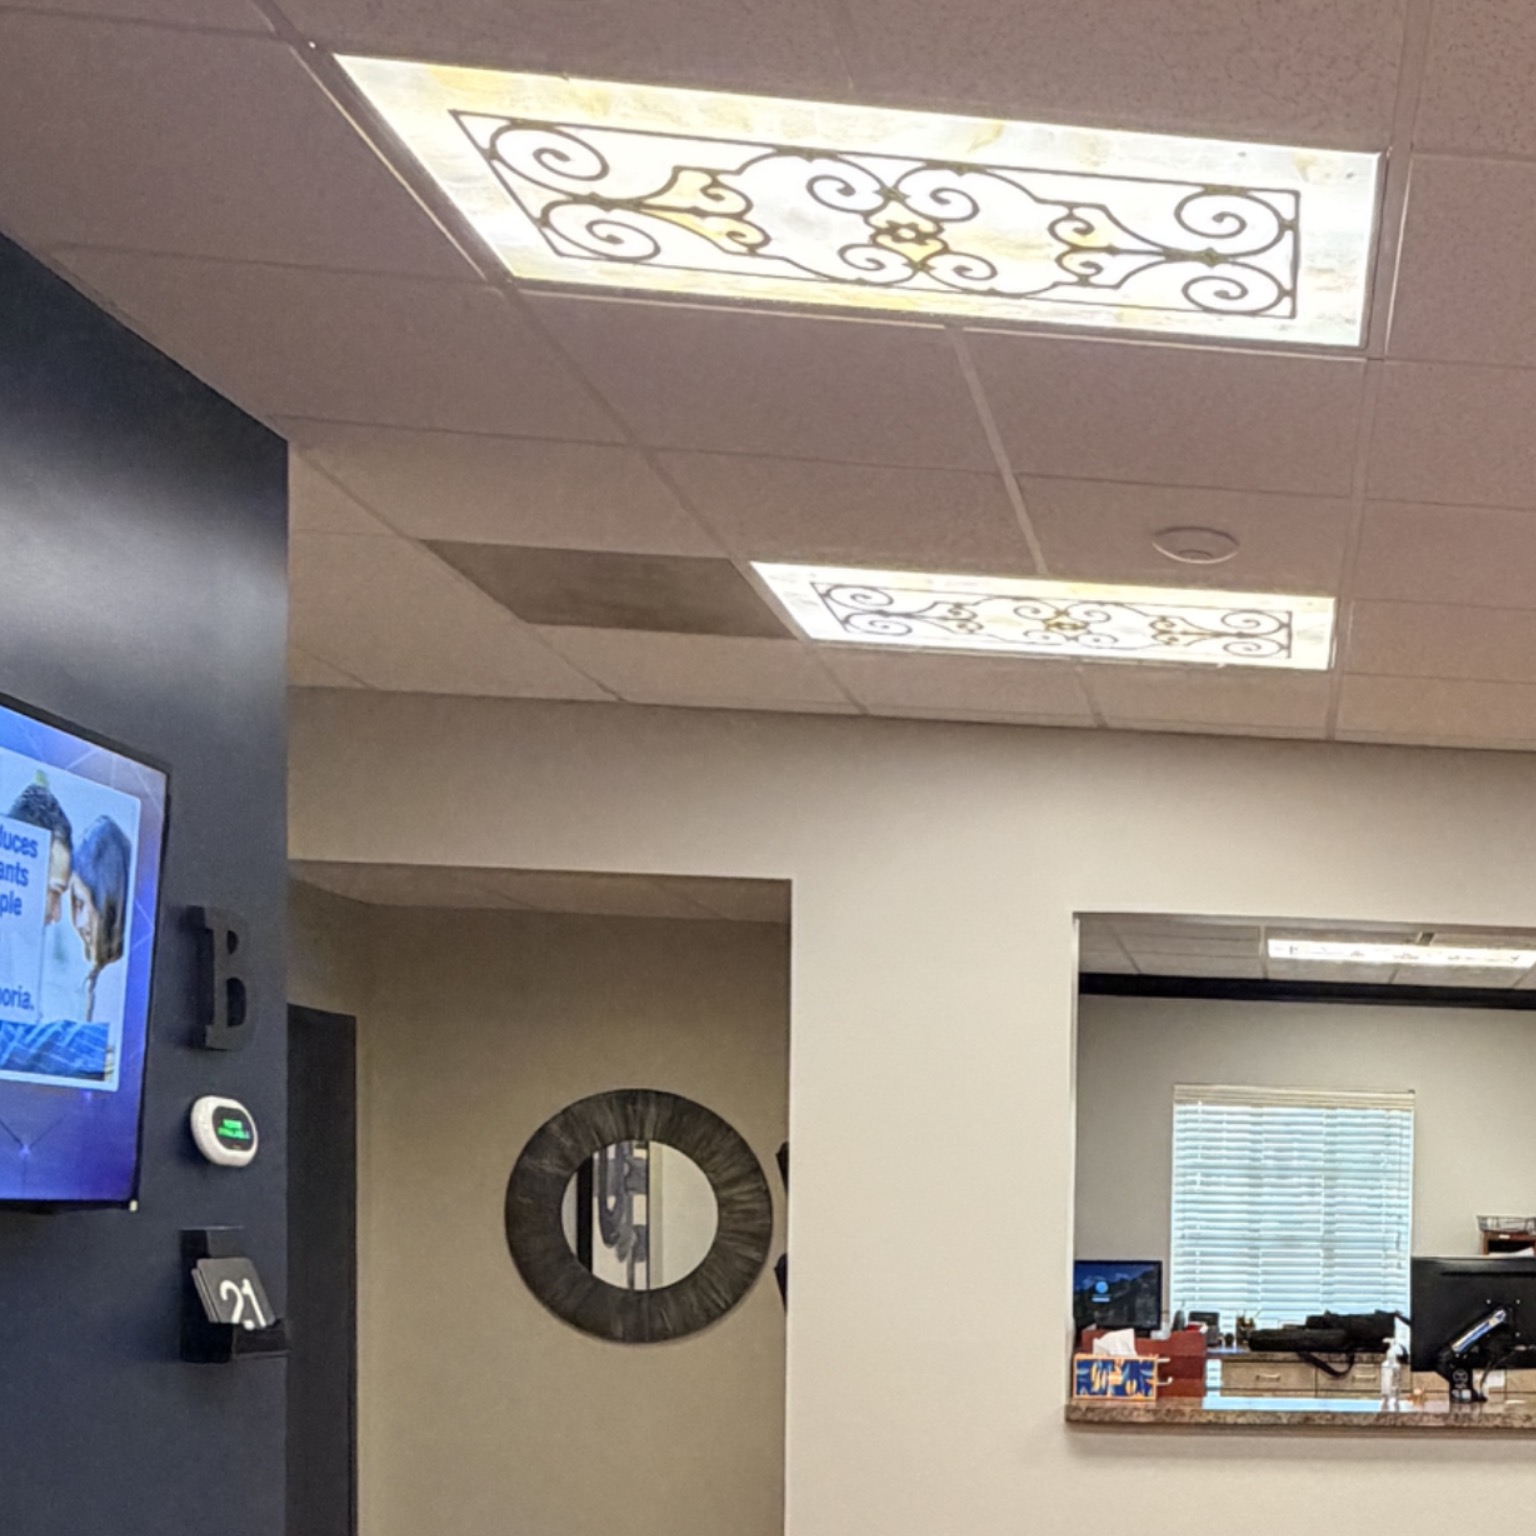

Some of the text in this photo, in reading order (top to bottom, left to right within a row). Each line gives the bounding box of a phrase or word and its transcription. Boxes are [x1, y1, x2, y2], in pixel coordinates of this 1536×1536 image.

[0, 985, 35, 1011] oria.
[204, 908, 256, 1050] B
[219, 1278, 267, 1331] 21
